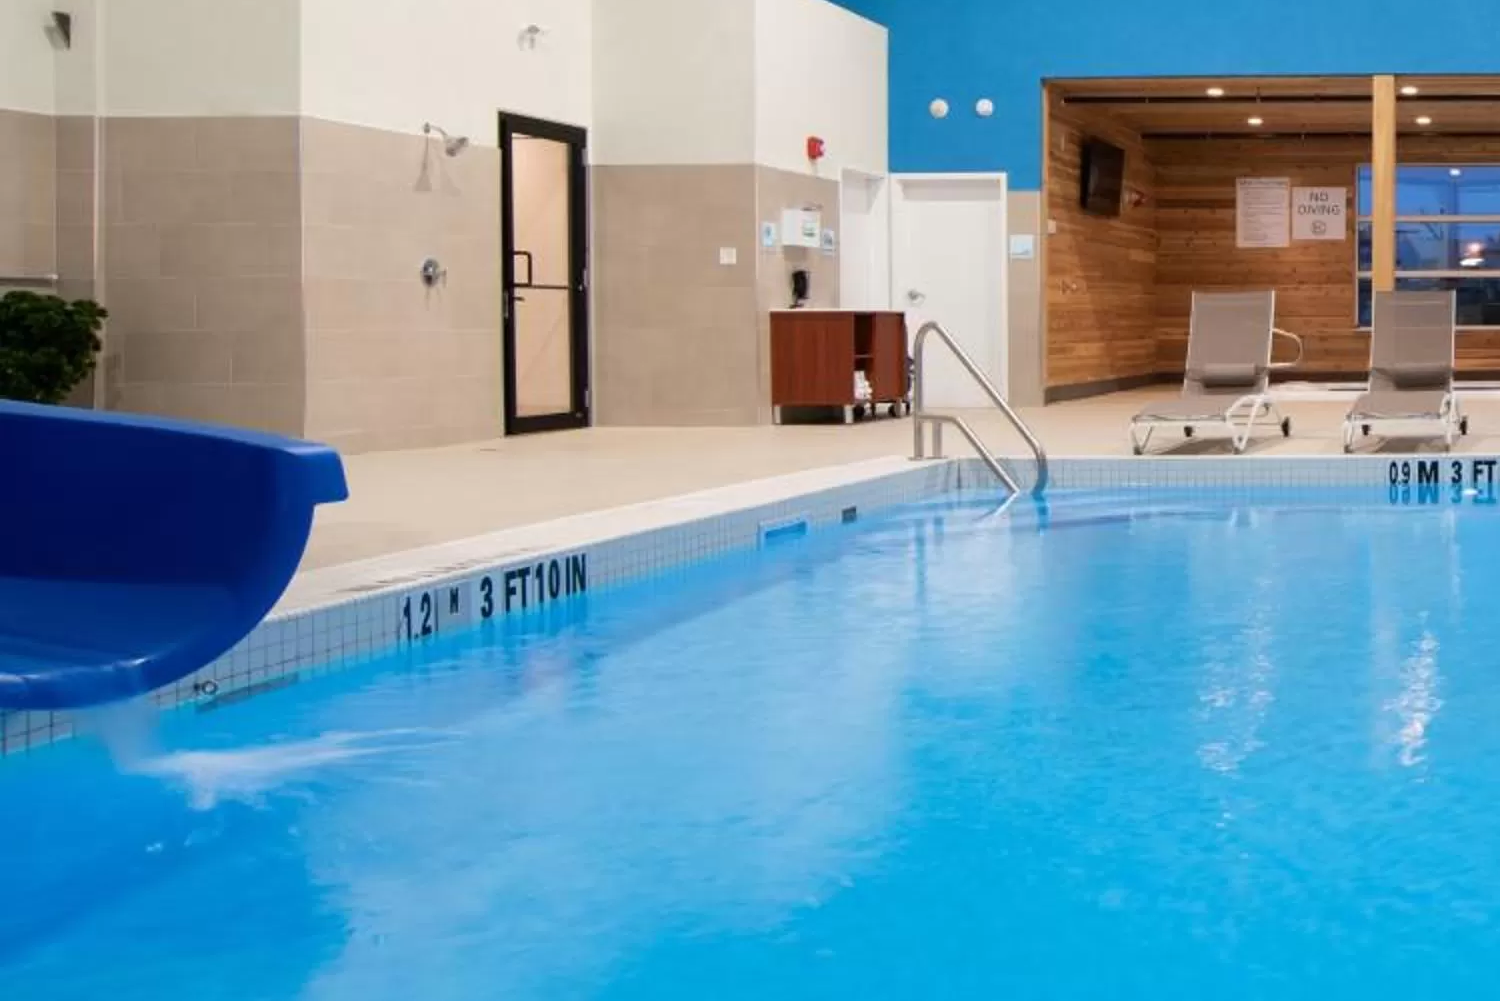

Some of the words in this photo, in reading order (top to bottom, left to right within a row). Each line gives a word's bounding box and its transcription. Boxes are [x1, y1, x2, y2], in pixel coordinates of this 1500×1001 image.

[1309, 191, 1328, 201] NO
[1298, 204, 1340, 215] DIVING
[1389, 462, 1411, 485] 0.9
[1418, 461, 1439, 483] M
[1451, 461, 1463, 484] 3
[1473, 460, 1497, 483] FT
[403, 592, 432, 640] 1.2
[480, 576, 493, 618] 3
[504, 566, 531, 612] FT
[536, 559, 560, 603] 10
[566, 553, 587, 596] IN
